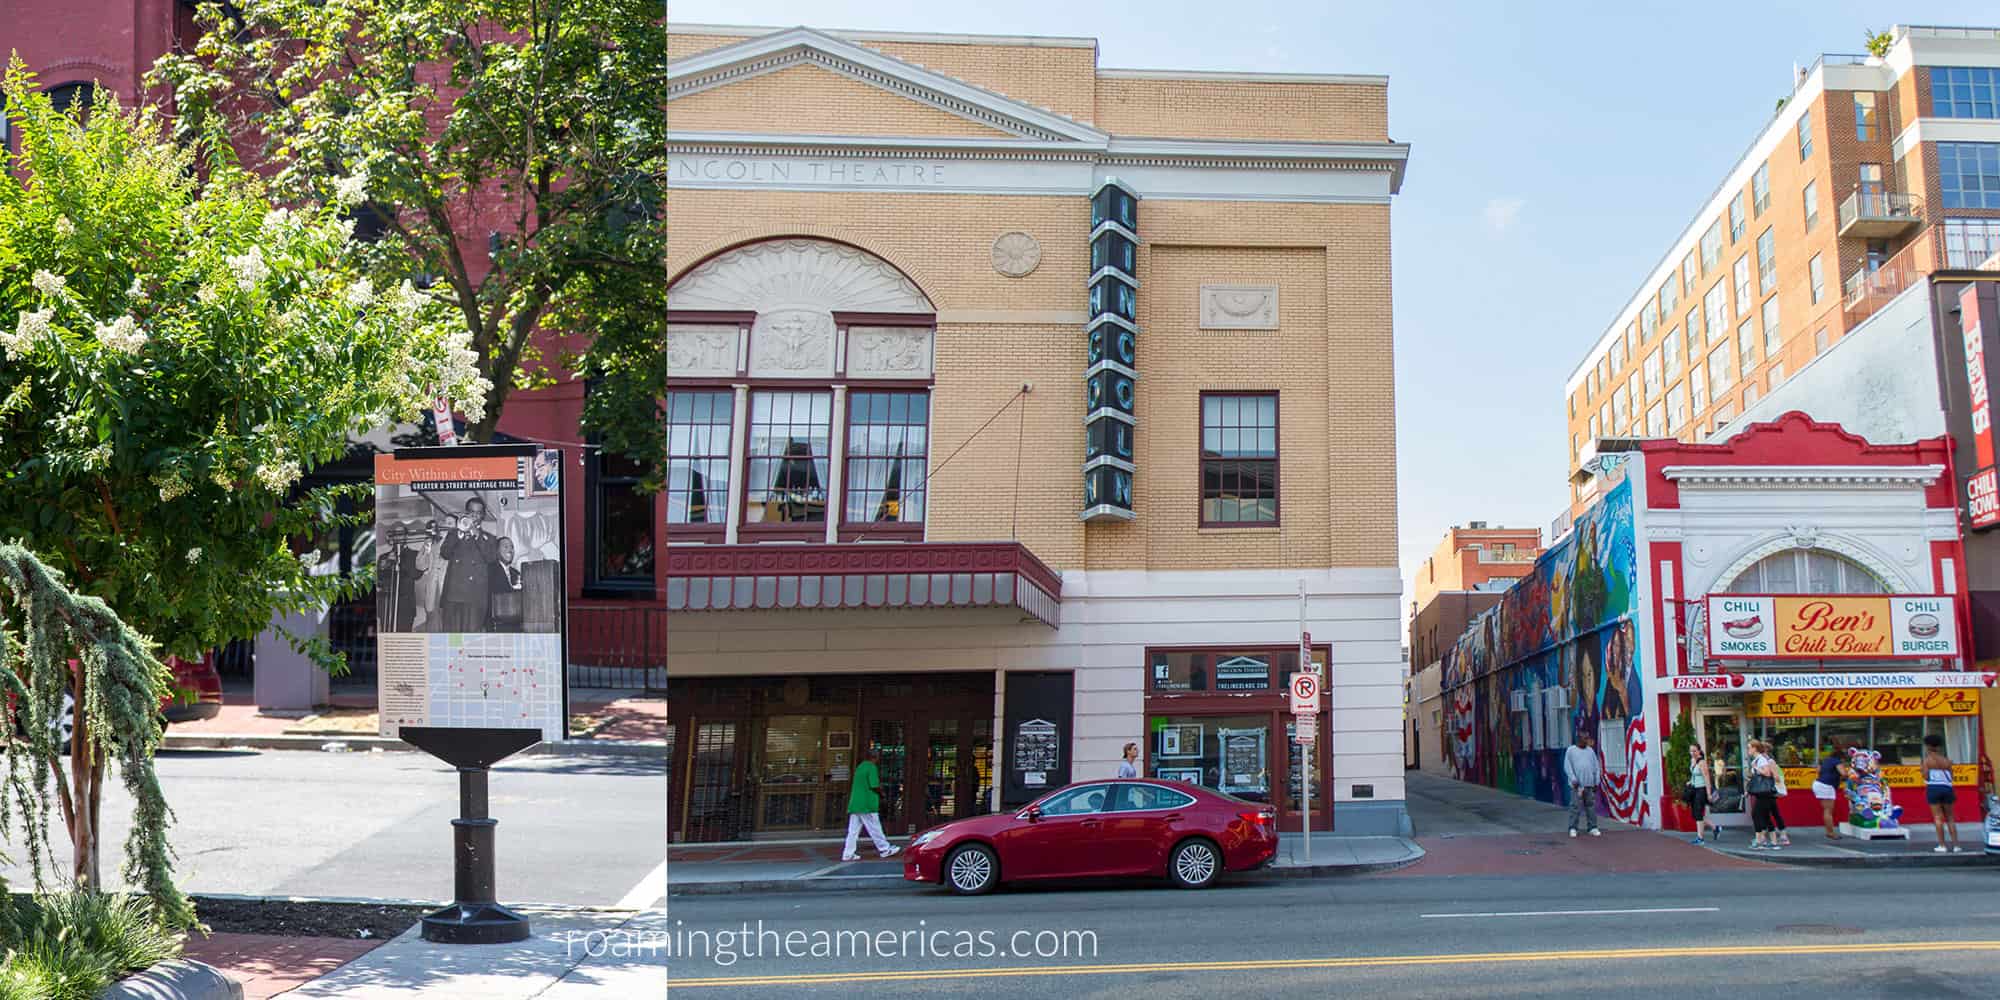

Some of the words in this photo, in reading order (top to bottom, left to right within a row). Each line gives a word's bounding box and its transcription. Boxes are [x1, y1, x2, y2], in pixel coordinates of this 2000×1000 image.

[807, 162, 946, 184] THEATRE
[1114, 195, 1136, 506] LINCOLN
[382, 469, 407, 483] City
[409, 466, 448, 481] Within
[450, 471, 457, 481] a
[459, 465, 485, 482] City
[412, 481, 438, 490] GREATER
[446, 481, 467, 489] STREET
[468, 480, 497, 489] HERITAGE
[498, 480, 517, 489] TRAIL
[1967, 471, 1997, 500] CHILI
[1969, 493, 2000, 517] BOWL
[1723, 601, 1761, 612] CHILI
[1904, 601, 1941, 612] CHILI
[1791, 601, 1876, 632] Ben's
[1720, 641, 1768, 652] SMOKES
[1784, 633, 1828, 654] Chili
[1830, 634, 1886, 654] Bowl
[1901, 640, 1950, 652] BURGER
[1751, 677, 1761, 688] A
[1763, 675, 1845, 687] WASHINGTON
[1847, 674, 1916, 686] LANDMARK
[1935, 674, 1968, 686] SINCE
[1803, 690, 1870, 712] Chili
[1873, 688, 1940, 712] Bowl
[1887, 776, 1914, 784] MOKES
